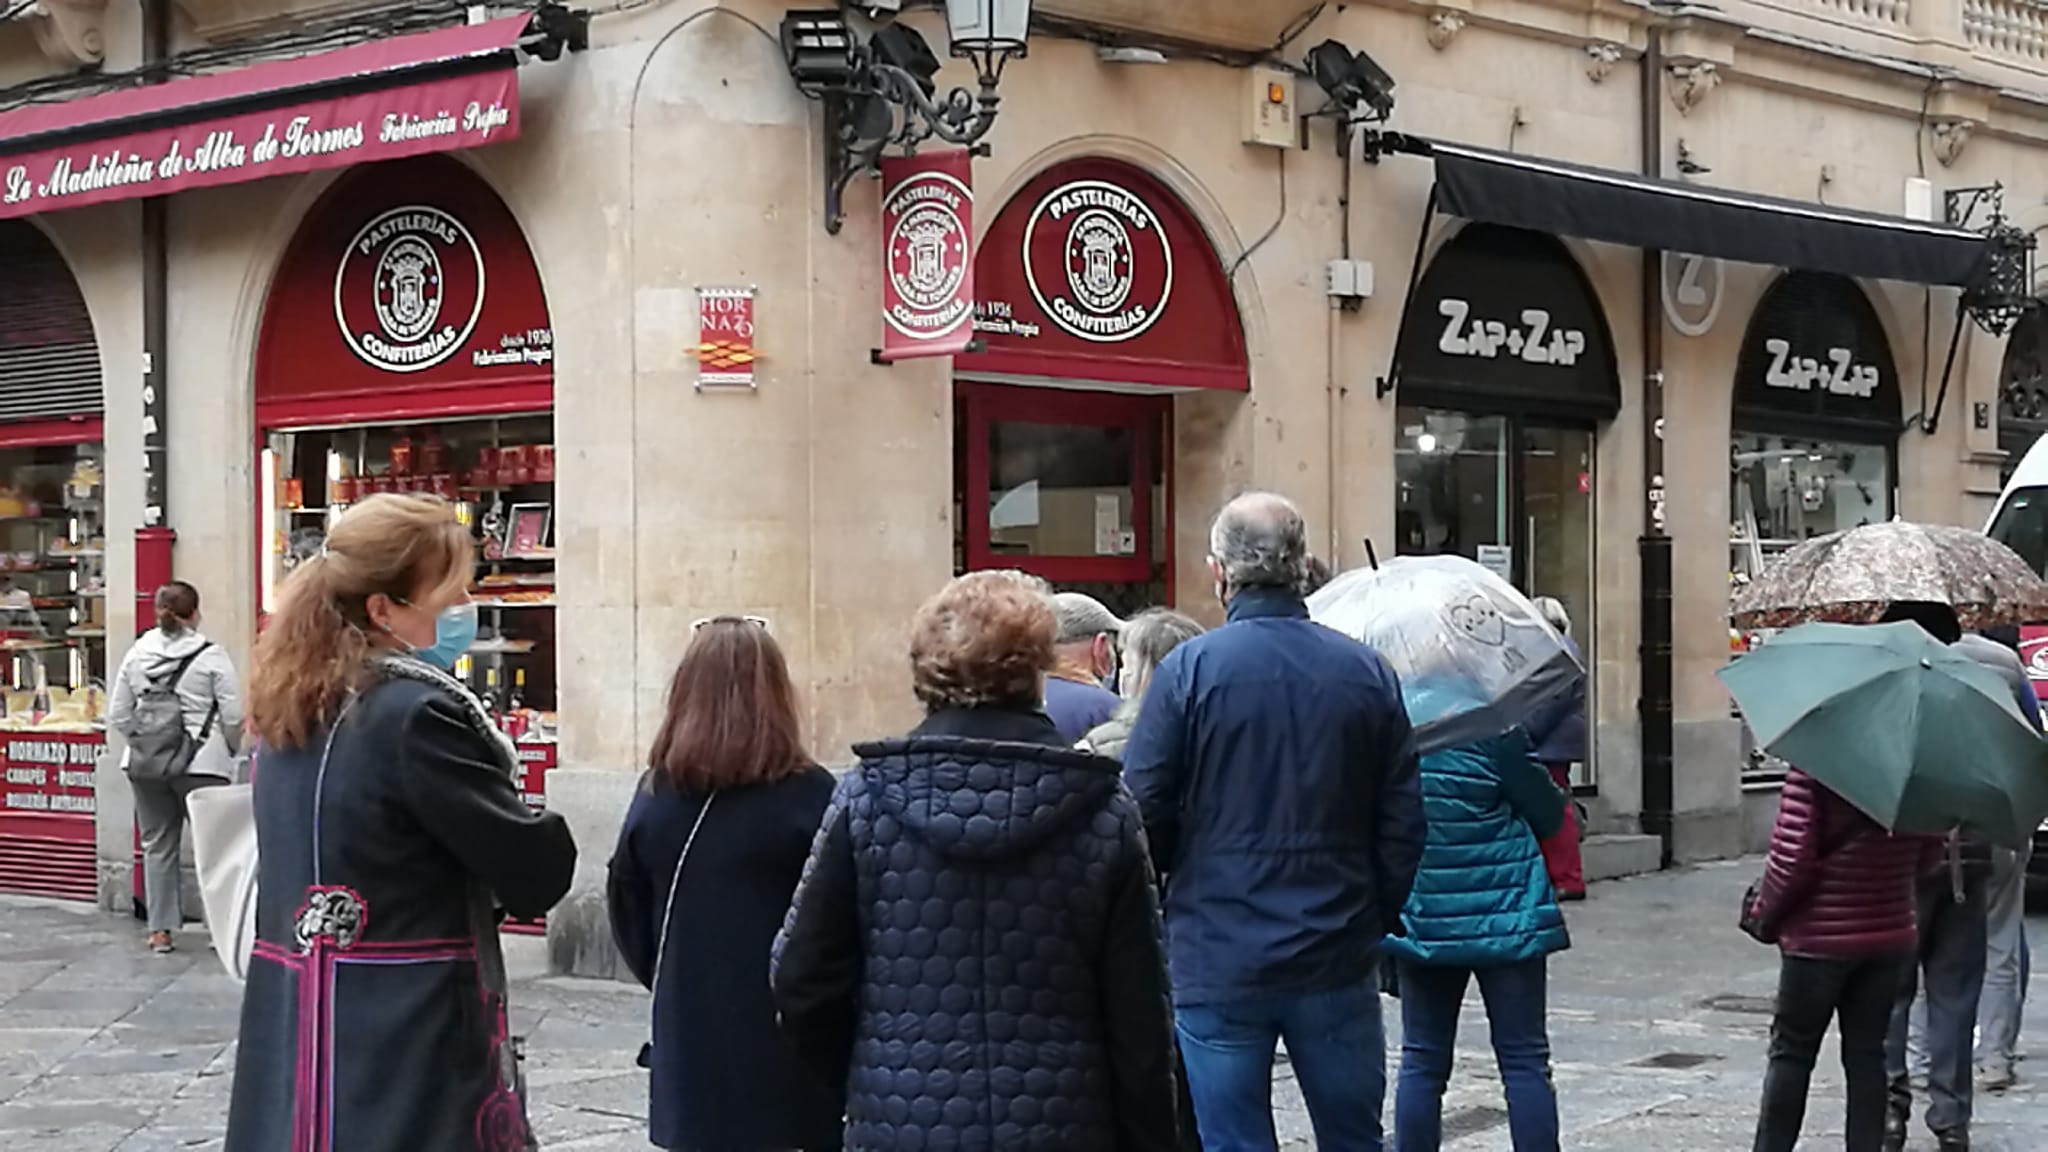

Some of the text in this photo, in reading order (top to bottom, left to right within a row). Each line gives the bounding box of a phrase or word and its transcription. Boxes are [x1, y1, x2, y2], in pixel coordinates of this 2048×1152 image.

[4, 165, 31, 204] La
[38, 150, 153, 197] Madrileña
[158, 140, 183, 179] de
[185, 131, 245, 172] Alba
[253, 124, 278, 163] de
[281, 116, 364, 157] Tormes
[379, 110, 457, 143] Fabricación
[890, 185, 961, 217] PASTELERÍAS
[1050, 188, 1149, 229] PASTELERÍAS
[359, 213, 458, 254] PASTELERÍAS
[702, 297, 748, 313] HOR
[892, 298, 964, 328] CONFITERÍAS
[1053, 296, 1146, 333] CONFITERÍAS
[701, 314, 754, 338] NAZO
[361, 324, 456, 363] CONFITERÍAS
[8, 741, 68, 763] HORNAZO
